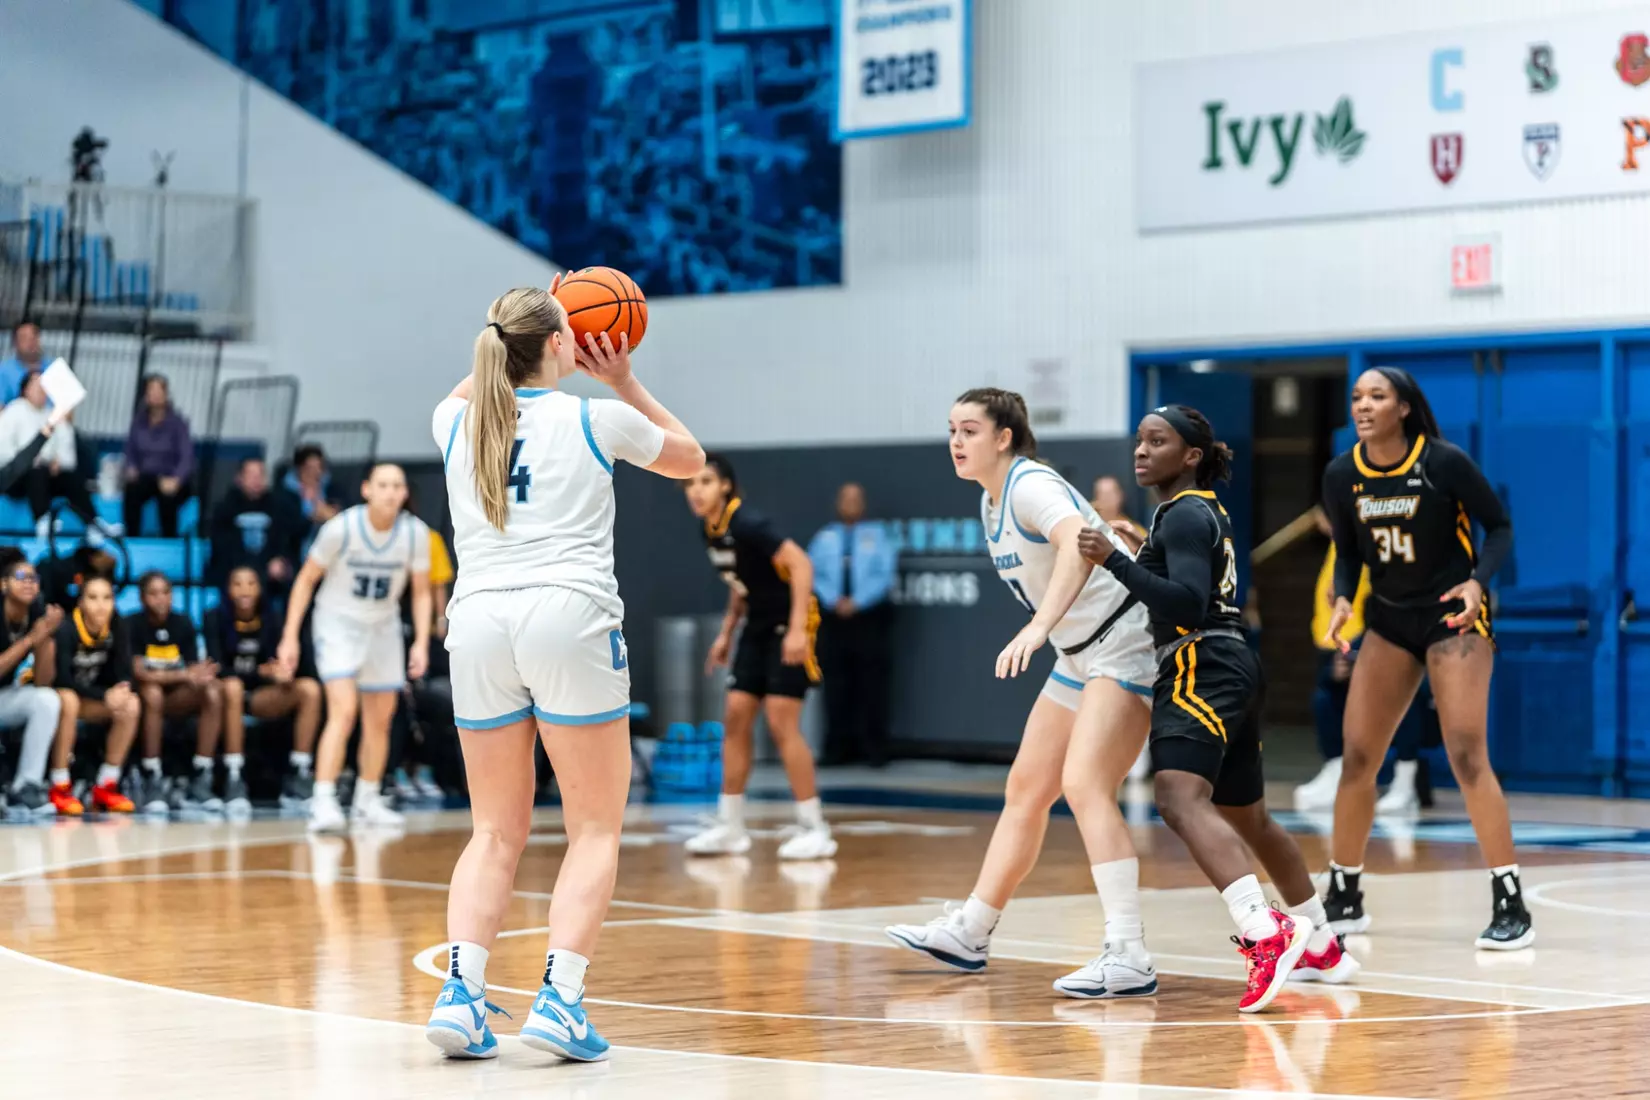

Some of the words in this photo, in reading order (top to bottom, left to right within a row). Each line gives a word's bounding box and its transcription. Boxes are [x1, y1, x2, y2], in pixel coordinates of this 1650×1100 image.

[862, 51, 937, 96] 2023
[1430, 48, 1464, 111] C
[1202, 102, 1303, 187] Ivy
[1452, 244, 1492, 286] EXIT
[1371, 525, 1416, 563] 34
[353, 573, 390, 600] 35
